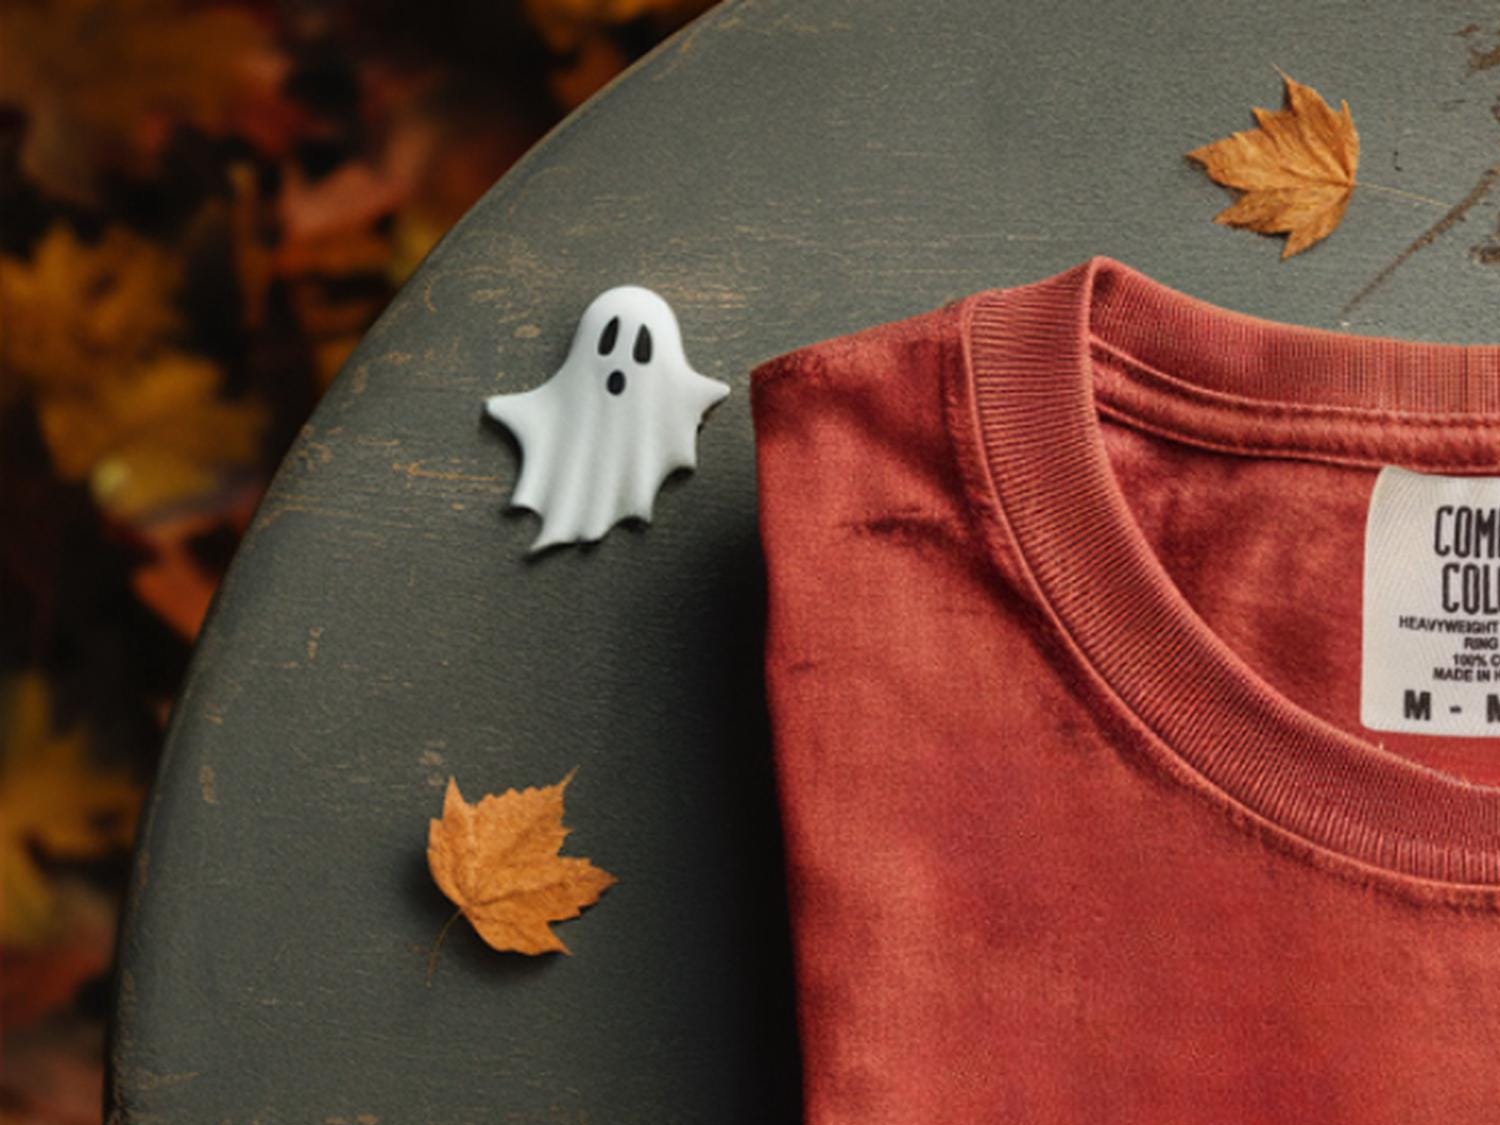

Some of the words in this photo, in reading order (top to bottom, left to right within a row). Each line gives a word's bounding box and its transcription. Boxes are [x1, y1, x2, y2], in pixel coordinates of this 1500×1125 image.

[1399, 615, 1499, 633] HEAVYWEIGHT
[1464, 636, 1499, 650] RING
[1453, 653, 1487, 667] 100%
[1433, 667, 1474, 682] MADE
[1477, 669, 1490, 682] IN
[1404, 689, 1431, 721] M
